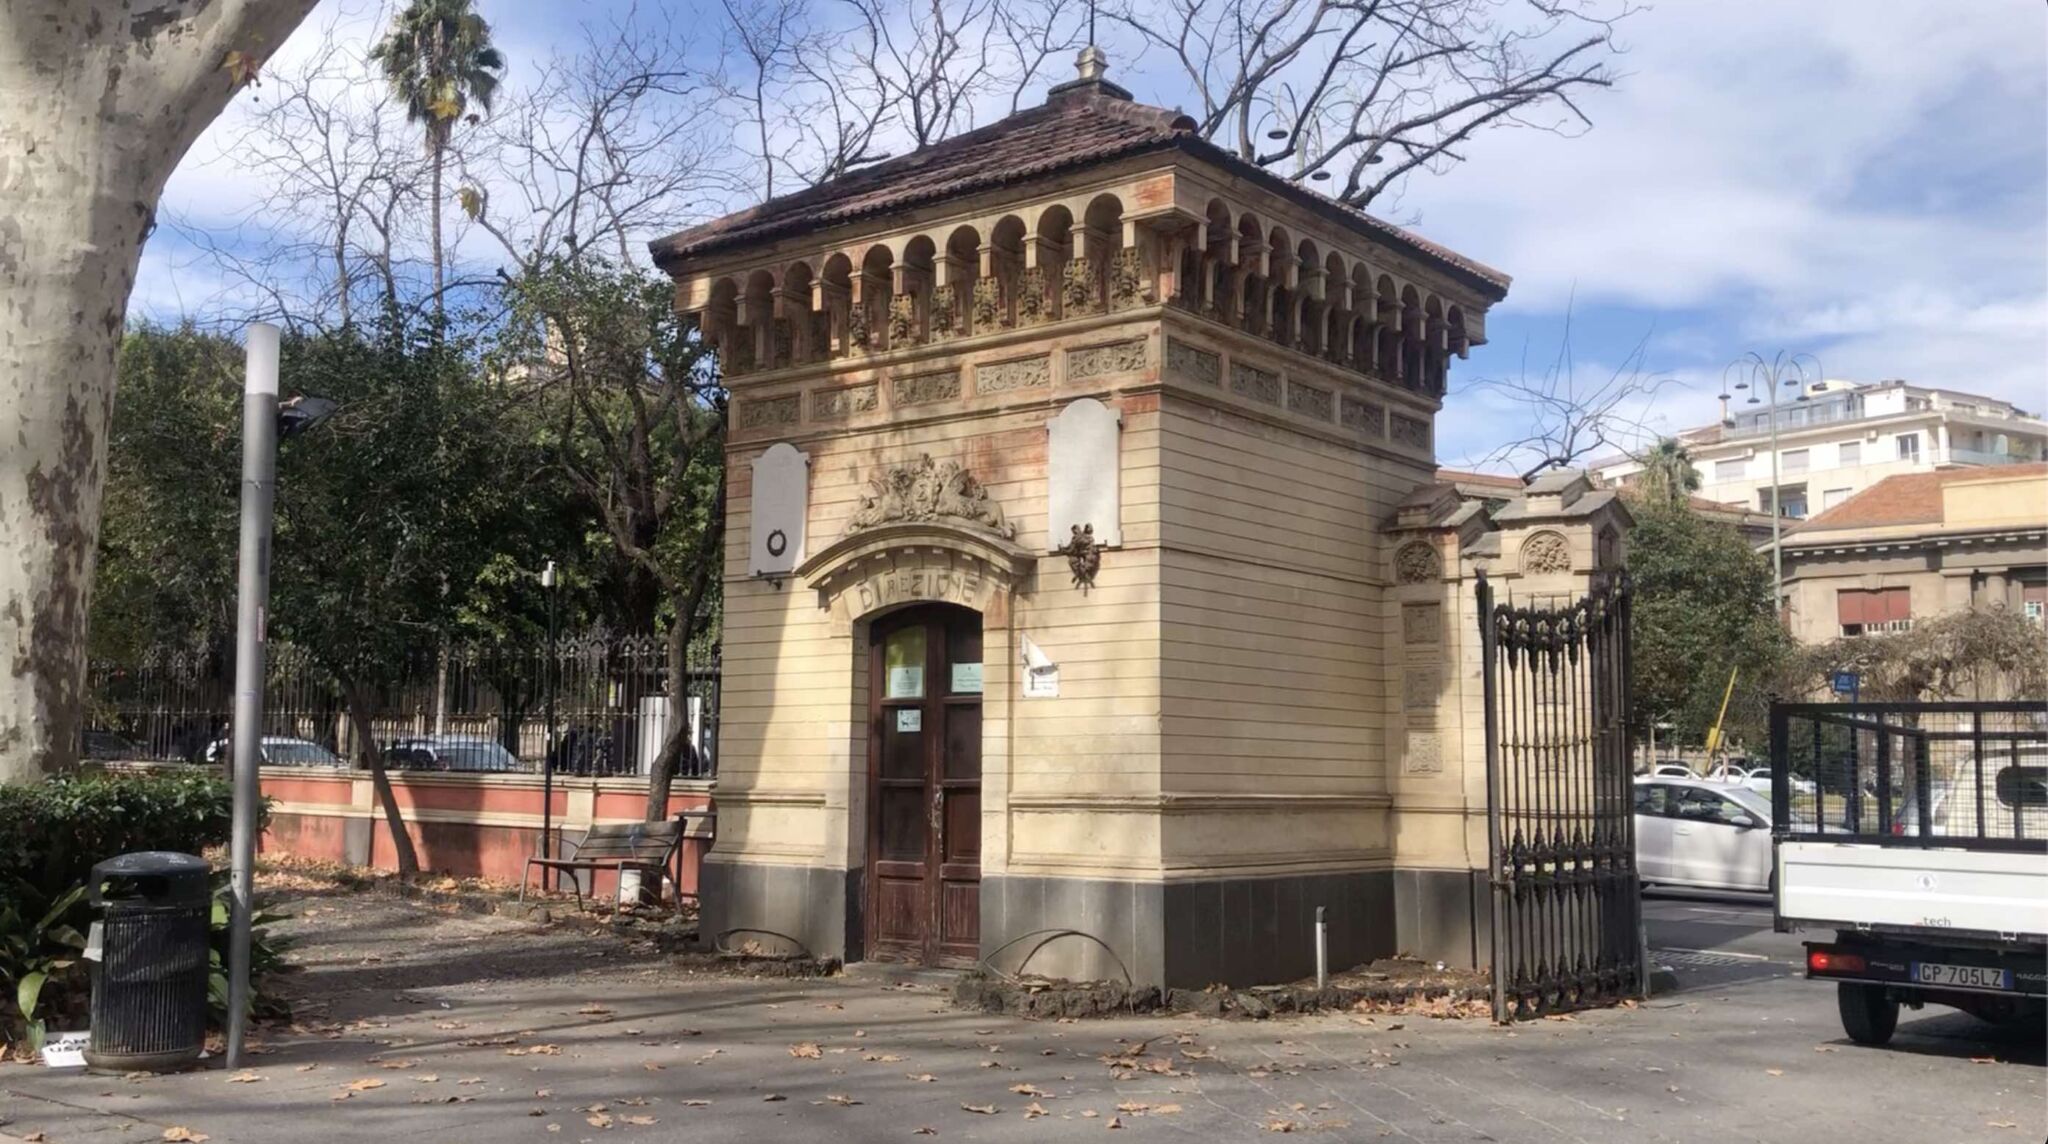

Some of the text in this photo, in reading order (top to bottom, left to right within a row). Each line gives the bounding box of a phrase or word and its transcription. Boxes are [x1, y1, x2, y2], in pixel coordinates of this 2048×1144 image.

[860, 574, 978, 610] DIREZIONE
[1922, 964, 1942, 981] GP
[1948, 966, 2002, 987] 705LZ
